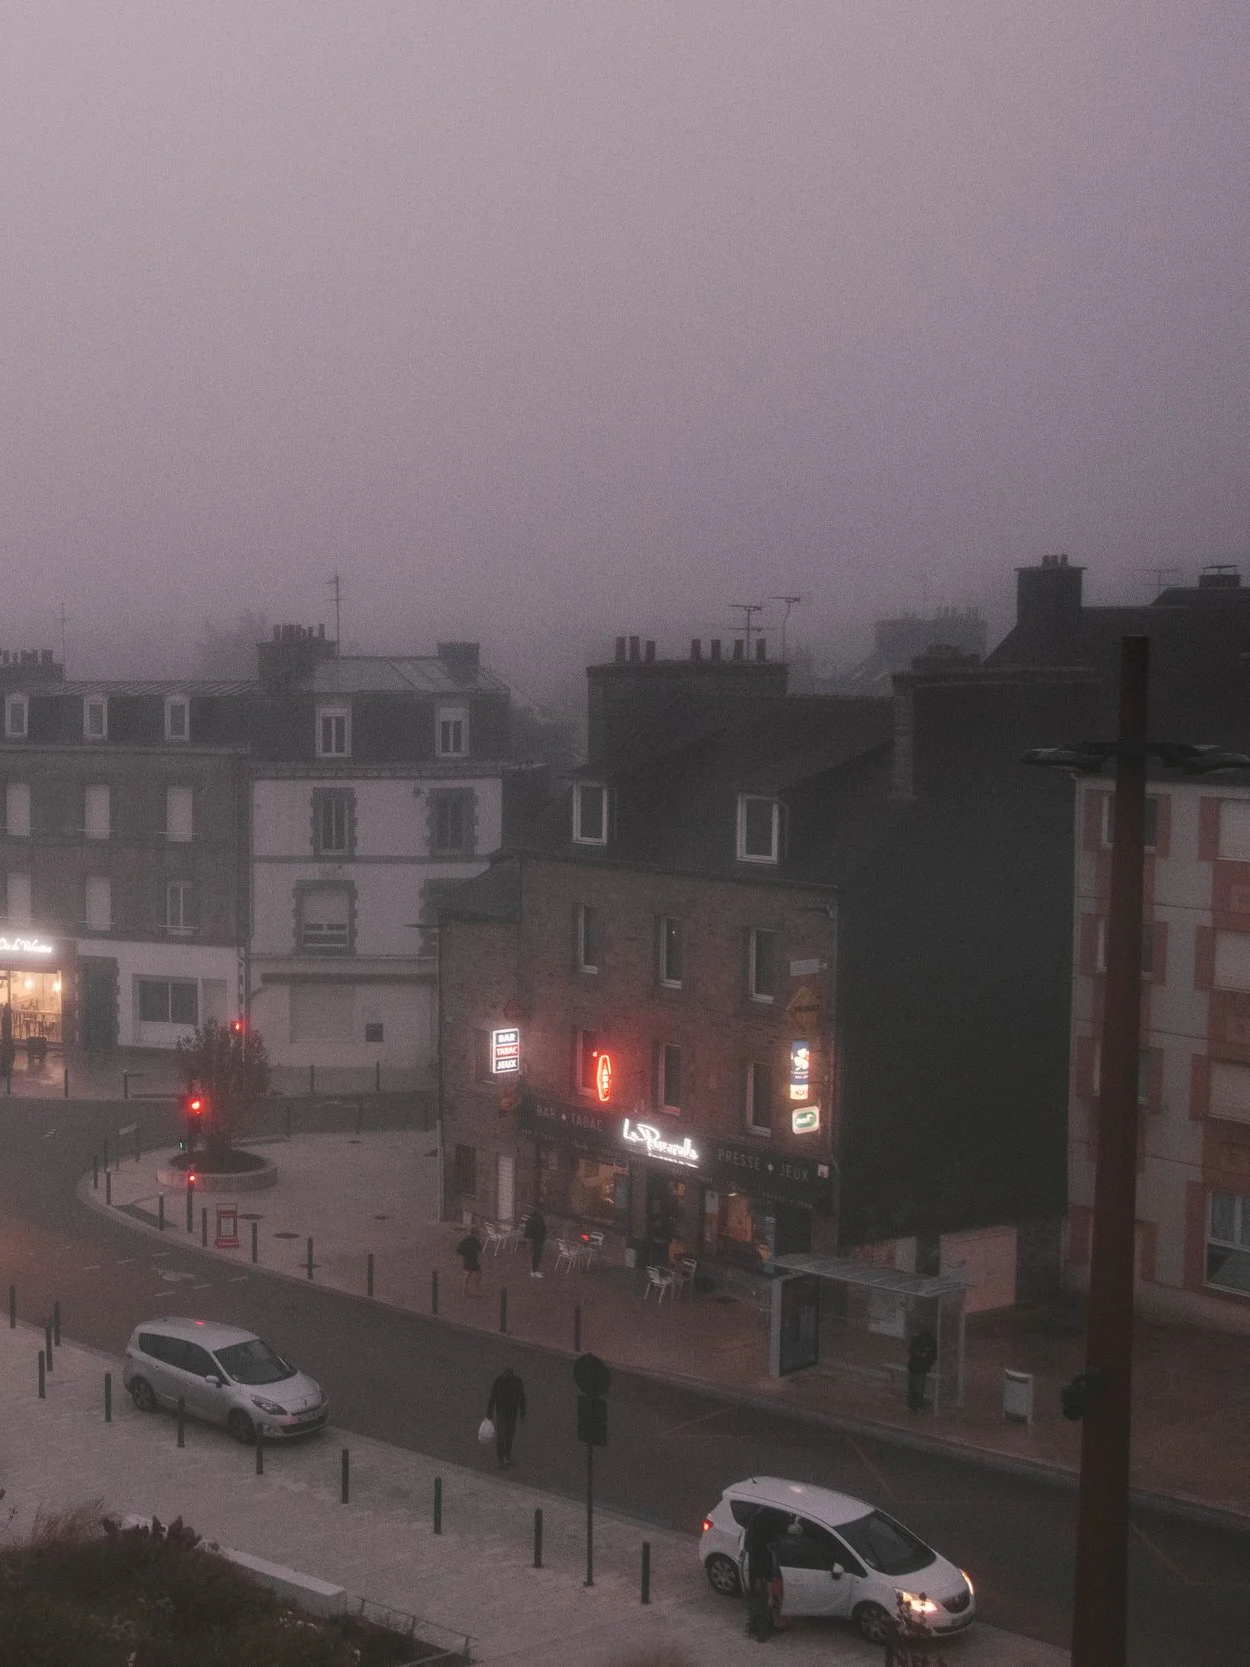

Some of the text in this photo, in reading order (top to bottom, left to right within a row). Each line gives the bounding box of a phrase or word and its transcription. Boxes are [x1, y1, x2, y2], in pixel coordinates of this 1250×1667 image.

[498, 1033, 516, 1043] BAR
[496, 1046, 518, 1057] TABAC
[497, 1059, 517, 1070] JEUX
[536, 1104, 603, 1132] BAR TABAC
[717, 1148, 809, 1182] PRESSE JEUX
